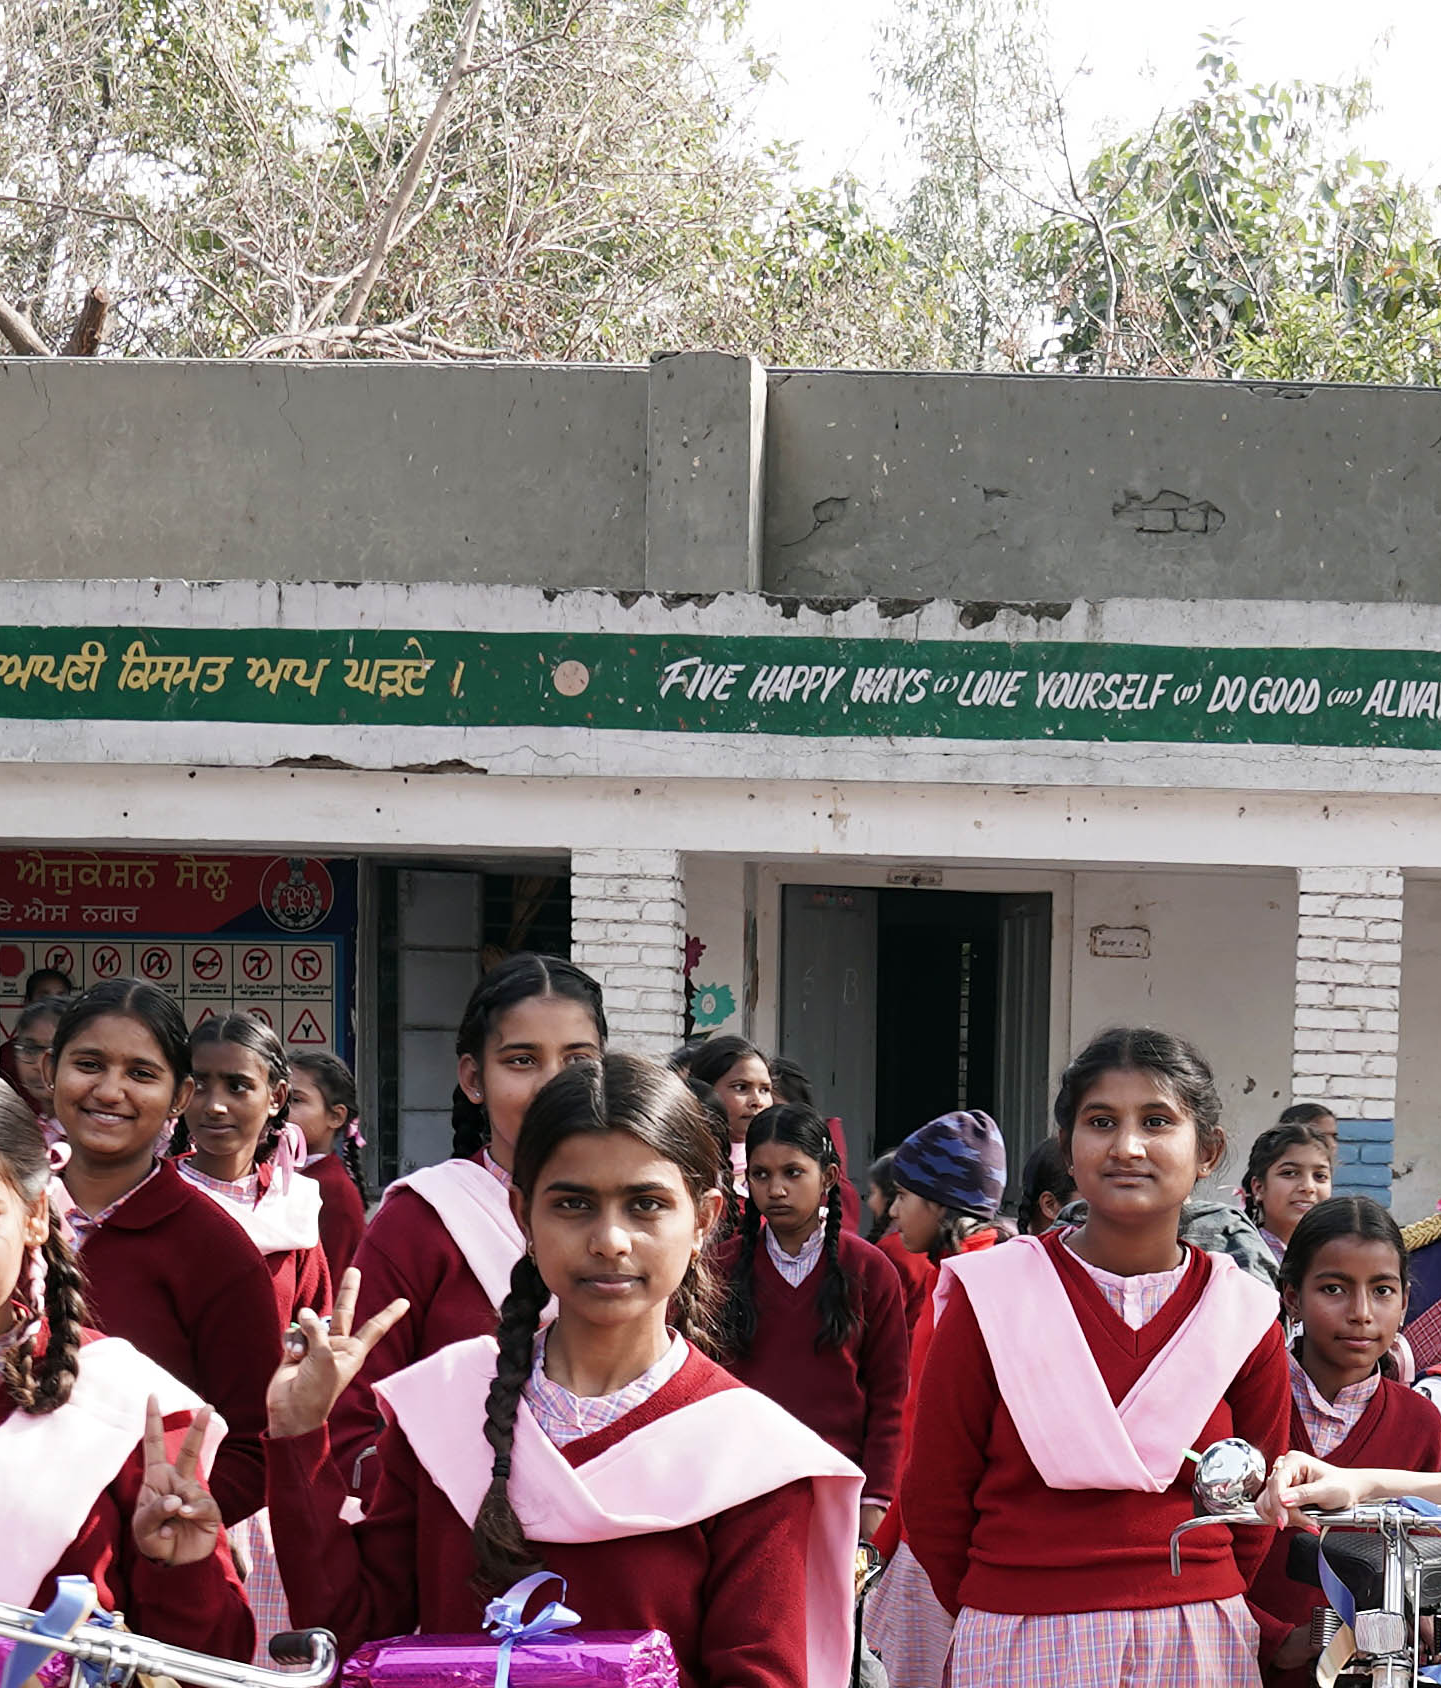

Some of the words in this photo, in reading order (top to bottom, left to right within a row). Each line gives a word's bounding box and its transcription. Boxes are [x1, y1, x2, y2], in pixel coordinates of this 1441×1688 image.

[118, 640, 234, 695] ਕਿਸਮਤ
[247, 658, 331, 697] ਆਪ
[659, 656, 745, 701] FIVE
[748, 664, 845, 704] HAPPY
[850, 665, 932, 703] WAYS
[958, 669, 1027, 708] LOVE
[1036, 671, 1174, 711] YOURSELF
[1207, 675, 1249, 715] DO
[1249, 675, 1322, 716] GOOD
[81, 905, 141, 923] ਨਗਰ
